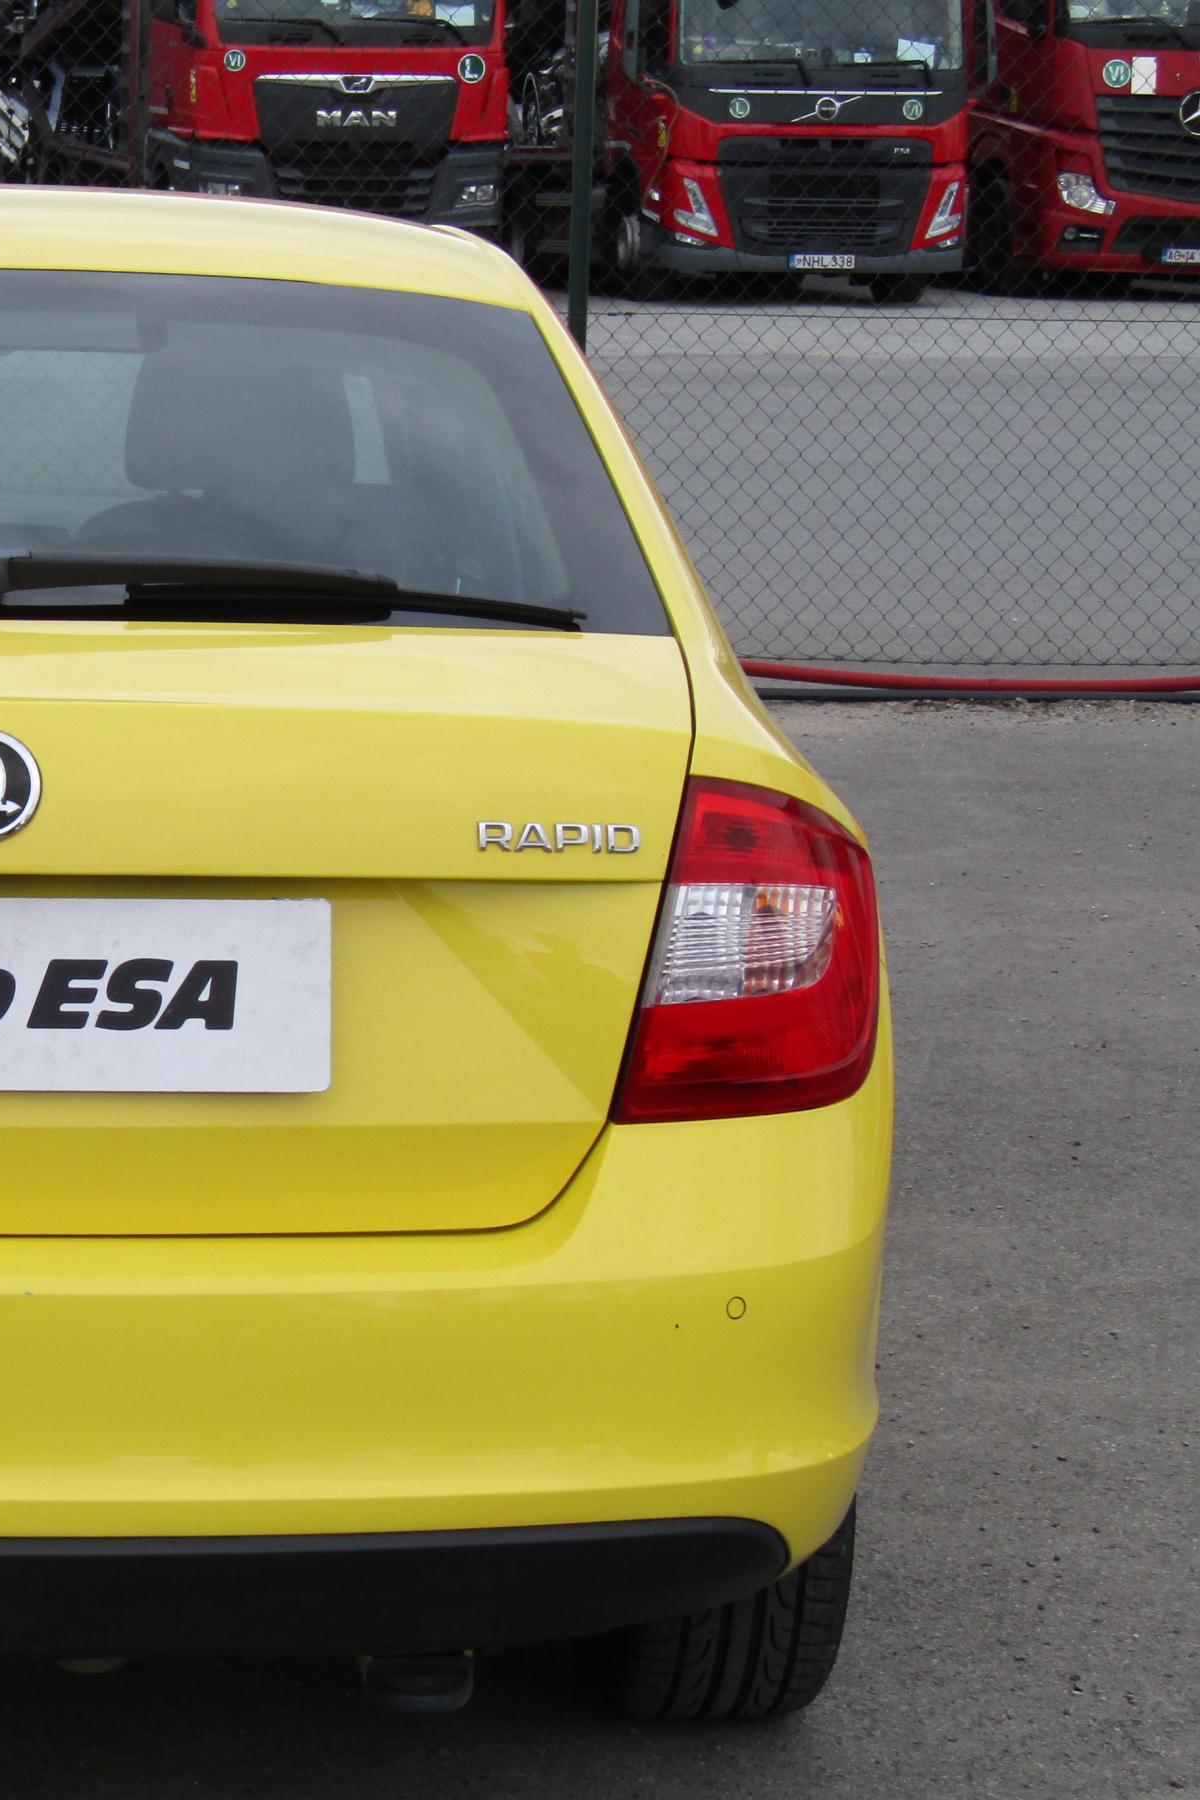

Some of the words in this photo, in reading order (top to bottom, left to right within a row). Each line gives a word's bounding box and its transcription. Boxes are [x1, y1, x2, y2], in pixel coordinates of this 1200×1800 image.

[229, 54, 241, 67] VI
[465, 58, 479, 78] L
[1108, 65, 1124, 81] VI
[316, 110, 397, 127] MAN
[478, 821, 642, 854] RAPID
[27, 958, 238, 1030] ESA
